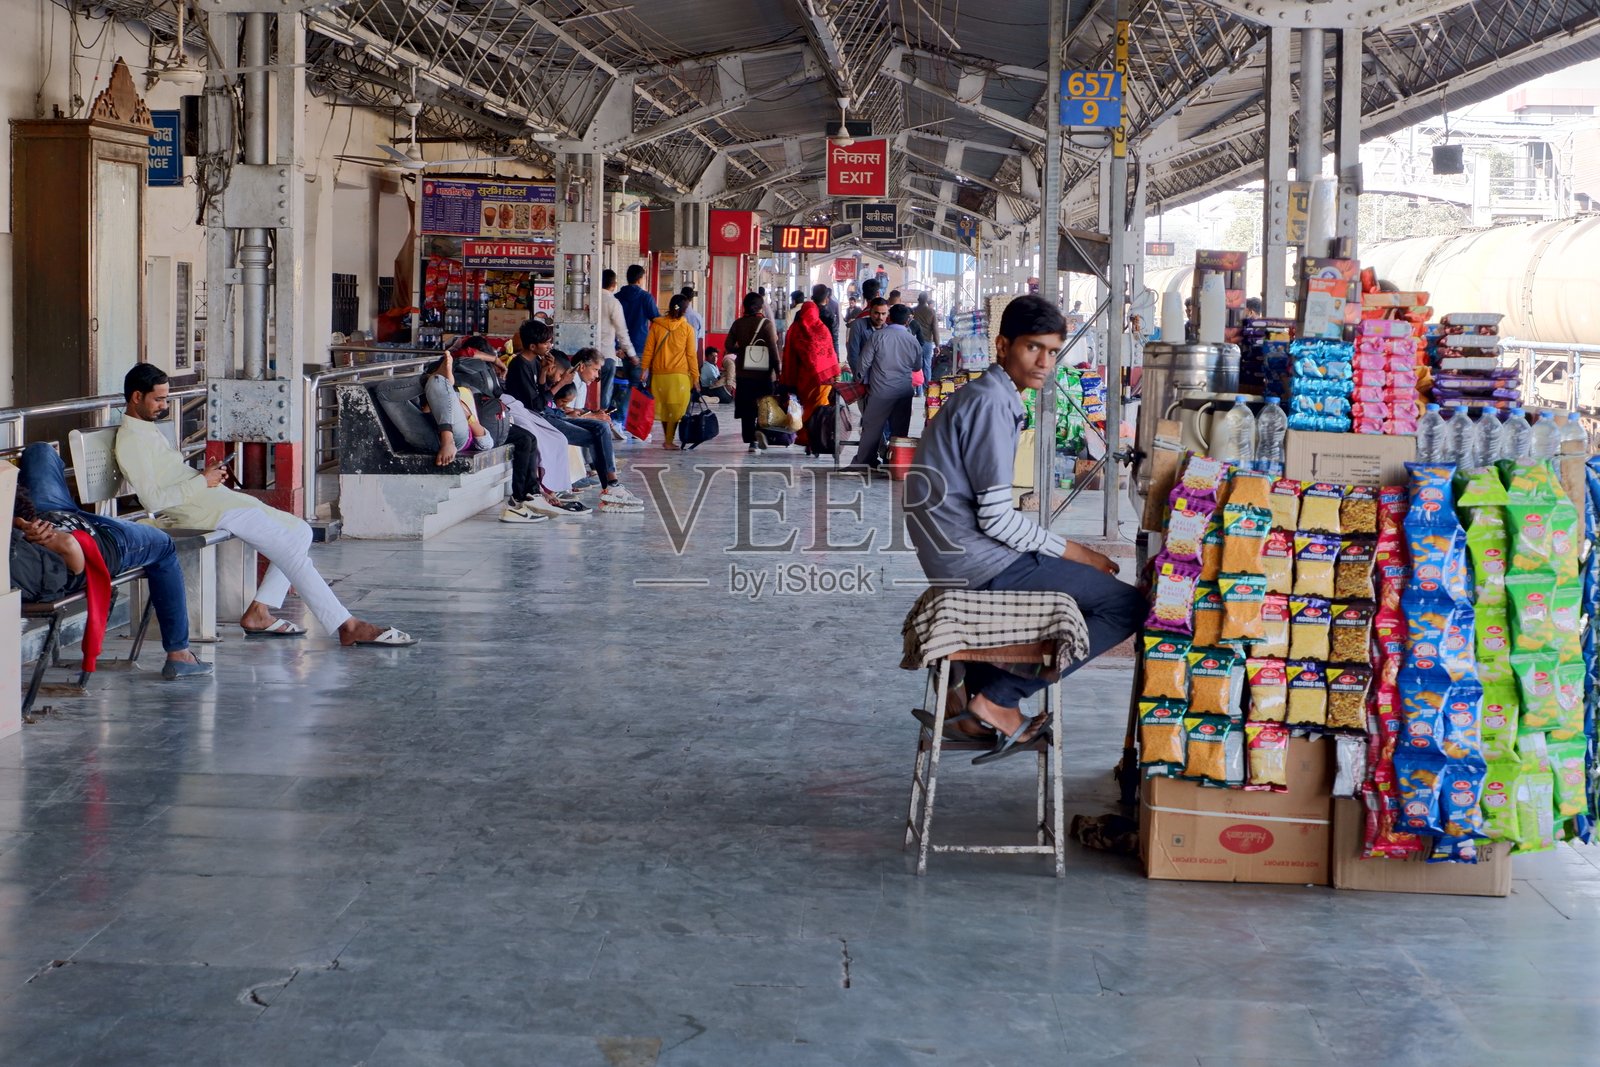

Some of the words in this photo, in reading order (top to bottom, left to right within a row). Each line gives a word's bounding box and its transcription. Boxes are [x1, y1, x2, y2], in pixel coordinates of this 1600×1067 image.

[1067, 72, 1115, 97] 657
[1082, 101, 1099, 124] 9
[1116, 125, 1126, 143] 9
[149, 146, 173, 156] OME
[832, 148, 881, 165] निकास
[148, 158, 169, 168] NGE
[839, 171, 873, 184] EXIT
[475, 245, 498, 255] MAY
[502, 245, 506, 255] I
[509, 246, 539, 256] HELP
[542, 246, 555, 257] YO
